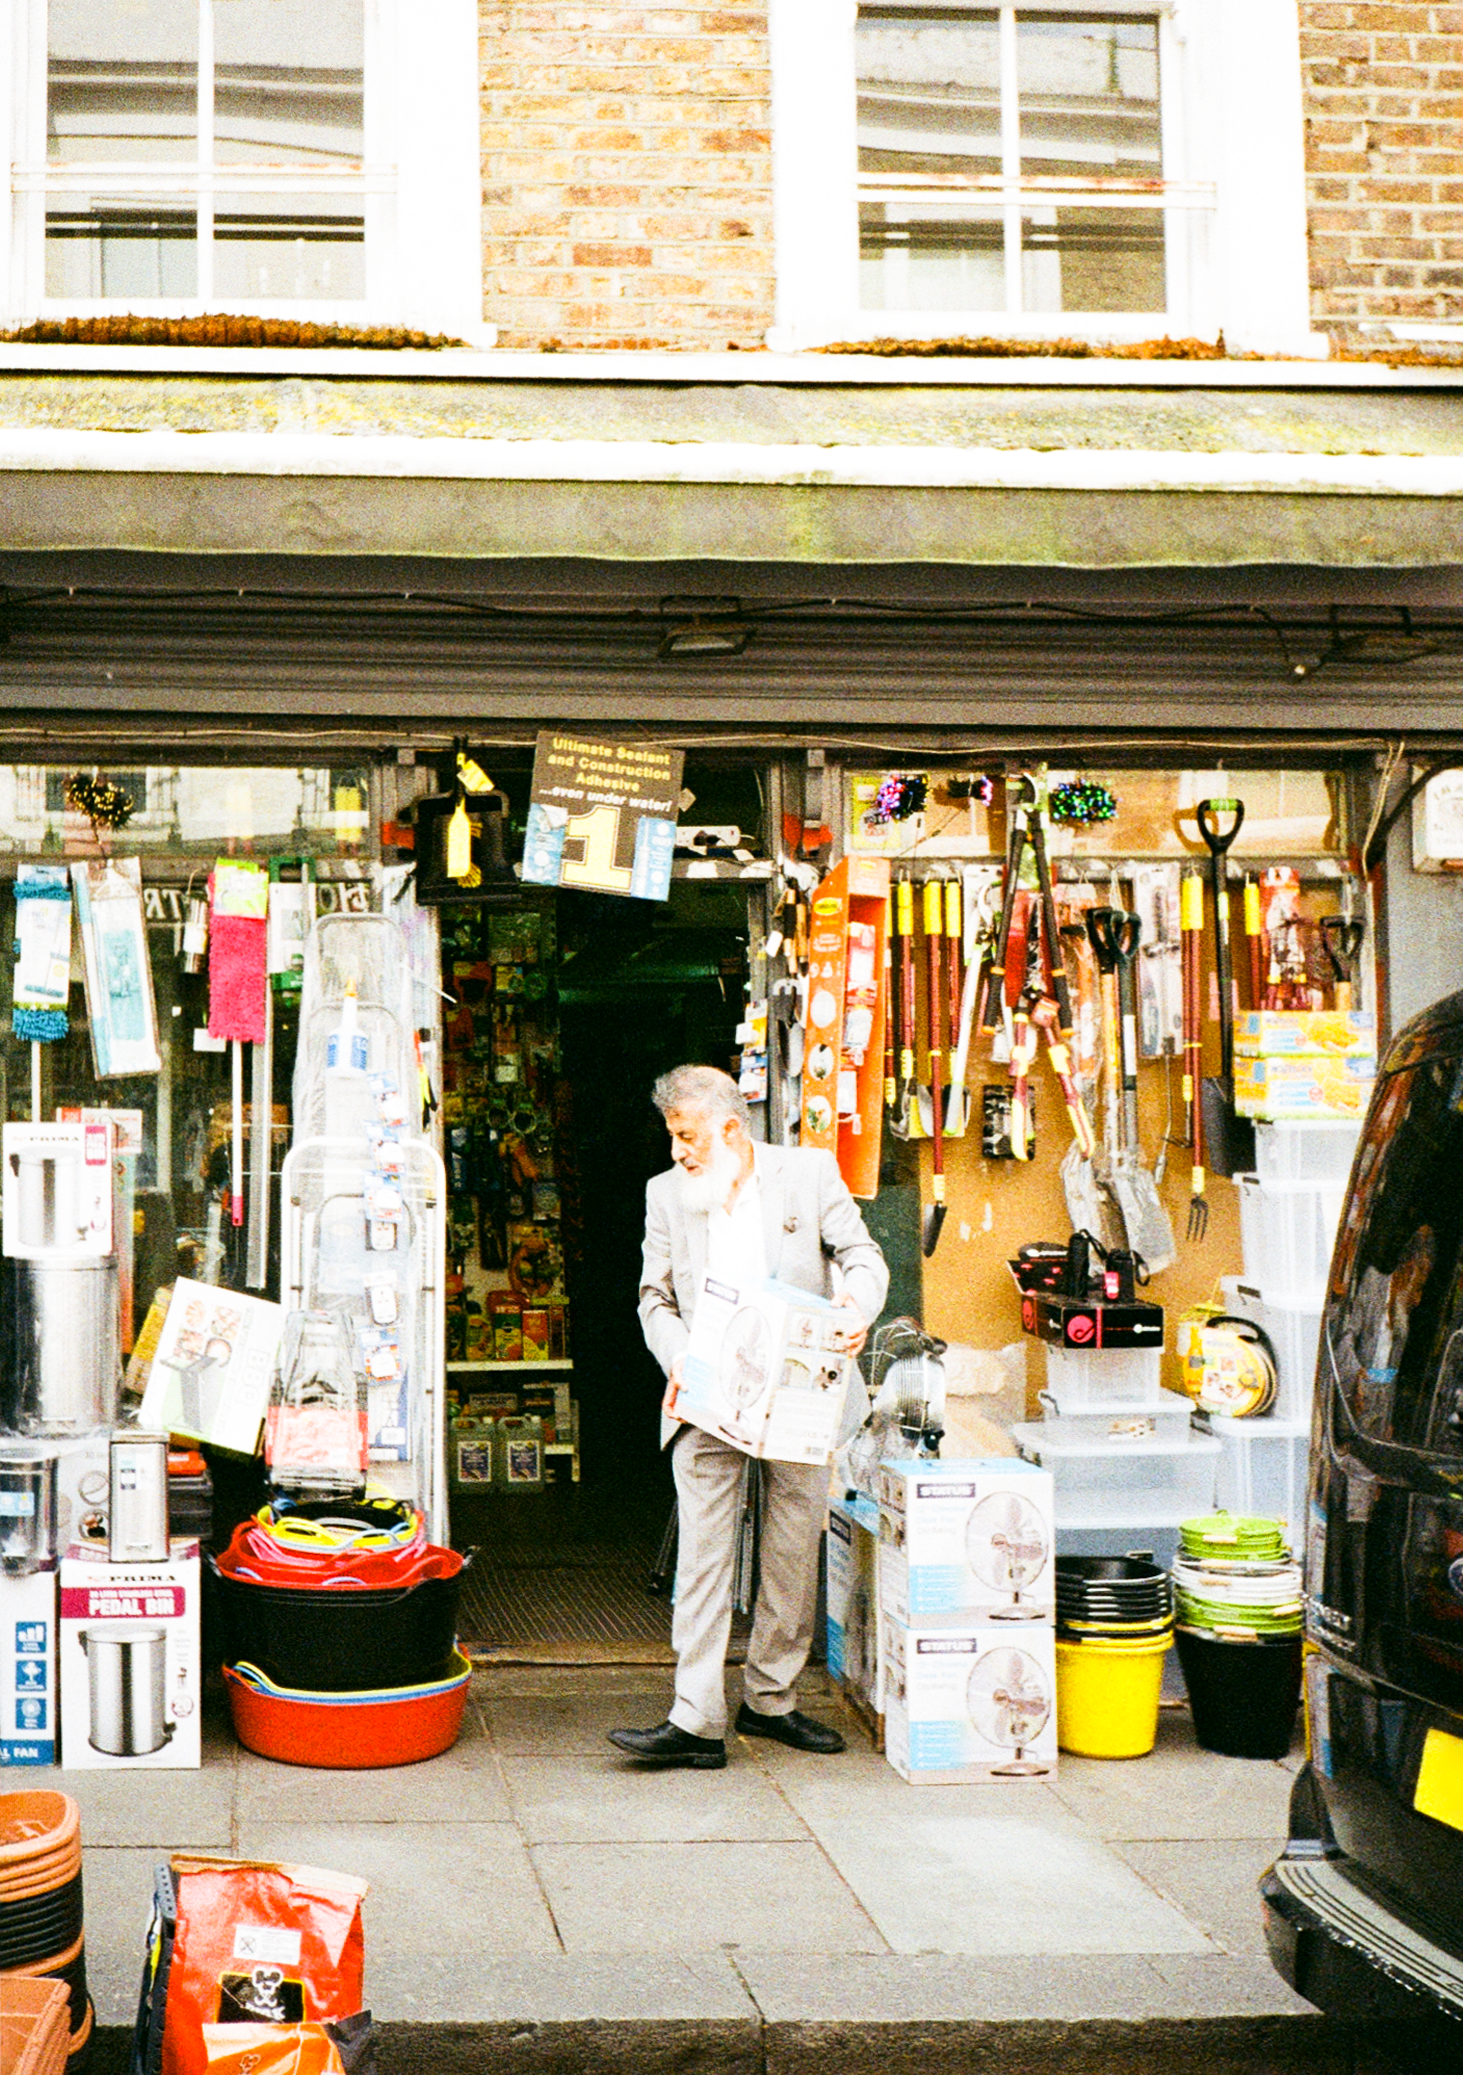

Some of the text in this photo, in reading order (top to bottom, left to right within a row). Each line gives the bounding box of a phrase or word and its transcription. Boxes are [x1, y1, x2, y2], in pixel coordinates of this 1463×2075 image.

[552, 737, 671, 765] Ultimate Sealant
[547, 754, 671, 781] and Construction
[575, 772, 640, 792] Adhesive
[586, 792, 627, 806] under
[629, 796, 673, 813] water!
[558, 804, 633, 893] 1
[89, 1597, 175, 1615] PEDAL BIN
[920, 1641, 973, 1651] STATUS
[13, 1747, 38, 1758] FAN
